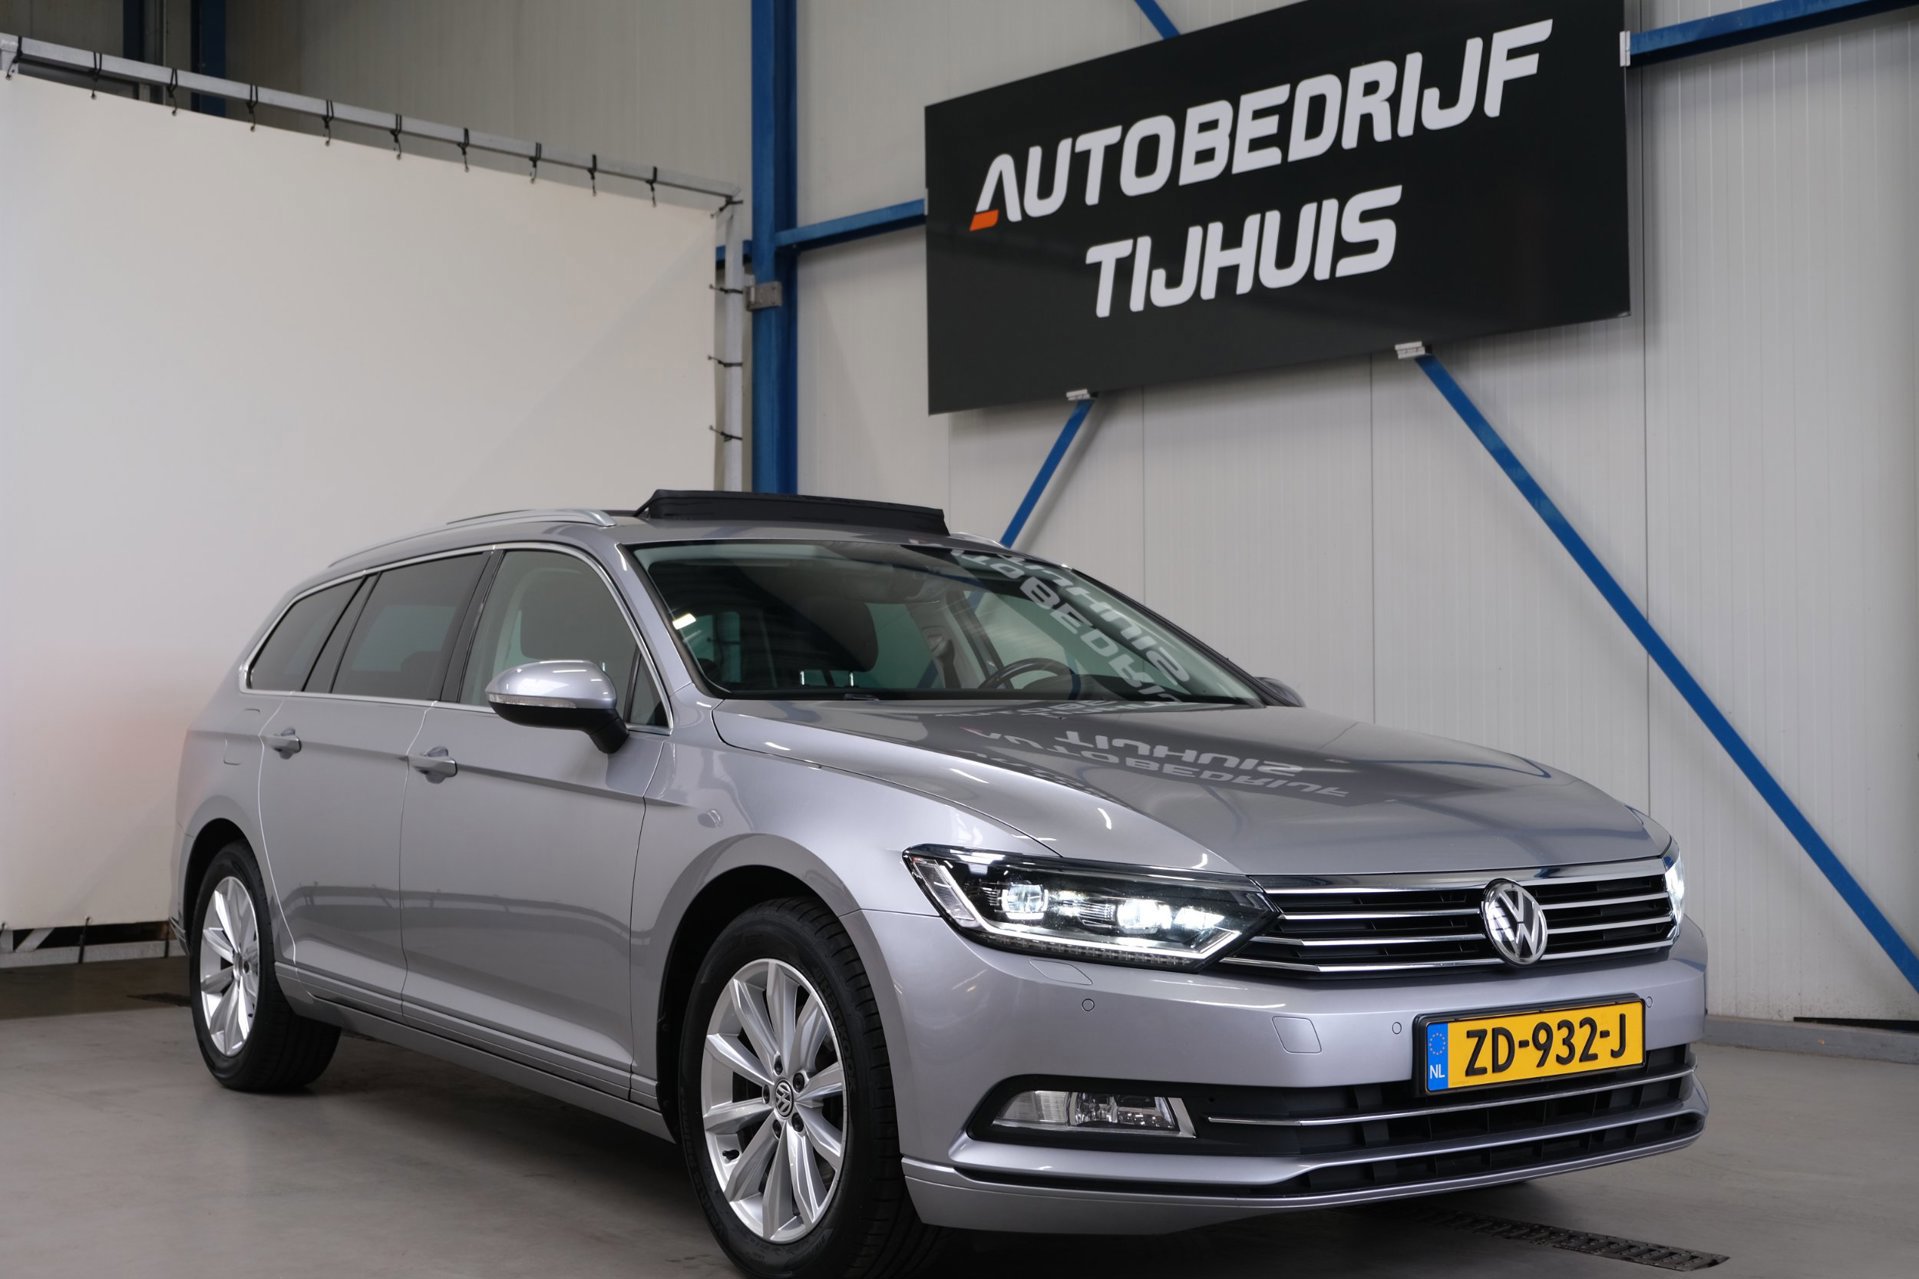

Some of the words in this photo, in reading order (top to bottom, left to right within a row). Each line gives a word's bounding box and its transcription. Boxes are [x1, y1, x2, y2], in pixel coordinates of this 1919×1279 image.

[970, 19, 1553, 231] AUTOBEDRIJF
[1085, 185, 1402, 318] TIJHUIS
[1483, 881, 1548, 965] VW
[1429, 1064, 1446, 1080] NL
[1465, 1013, 1627, 1077] ZD-932-J
